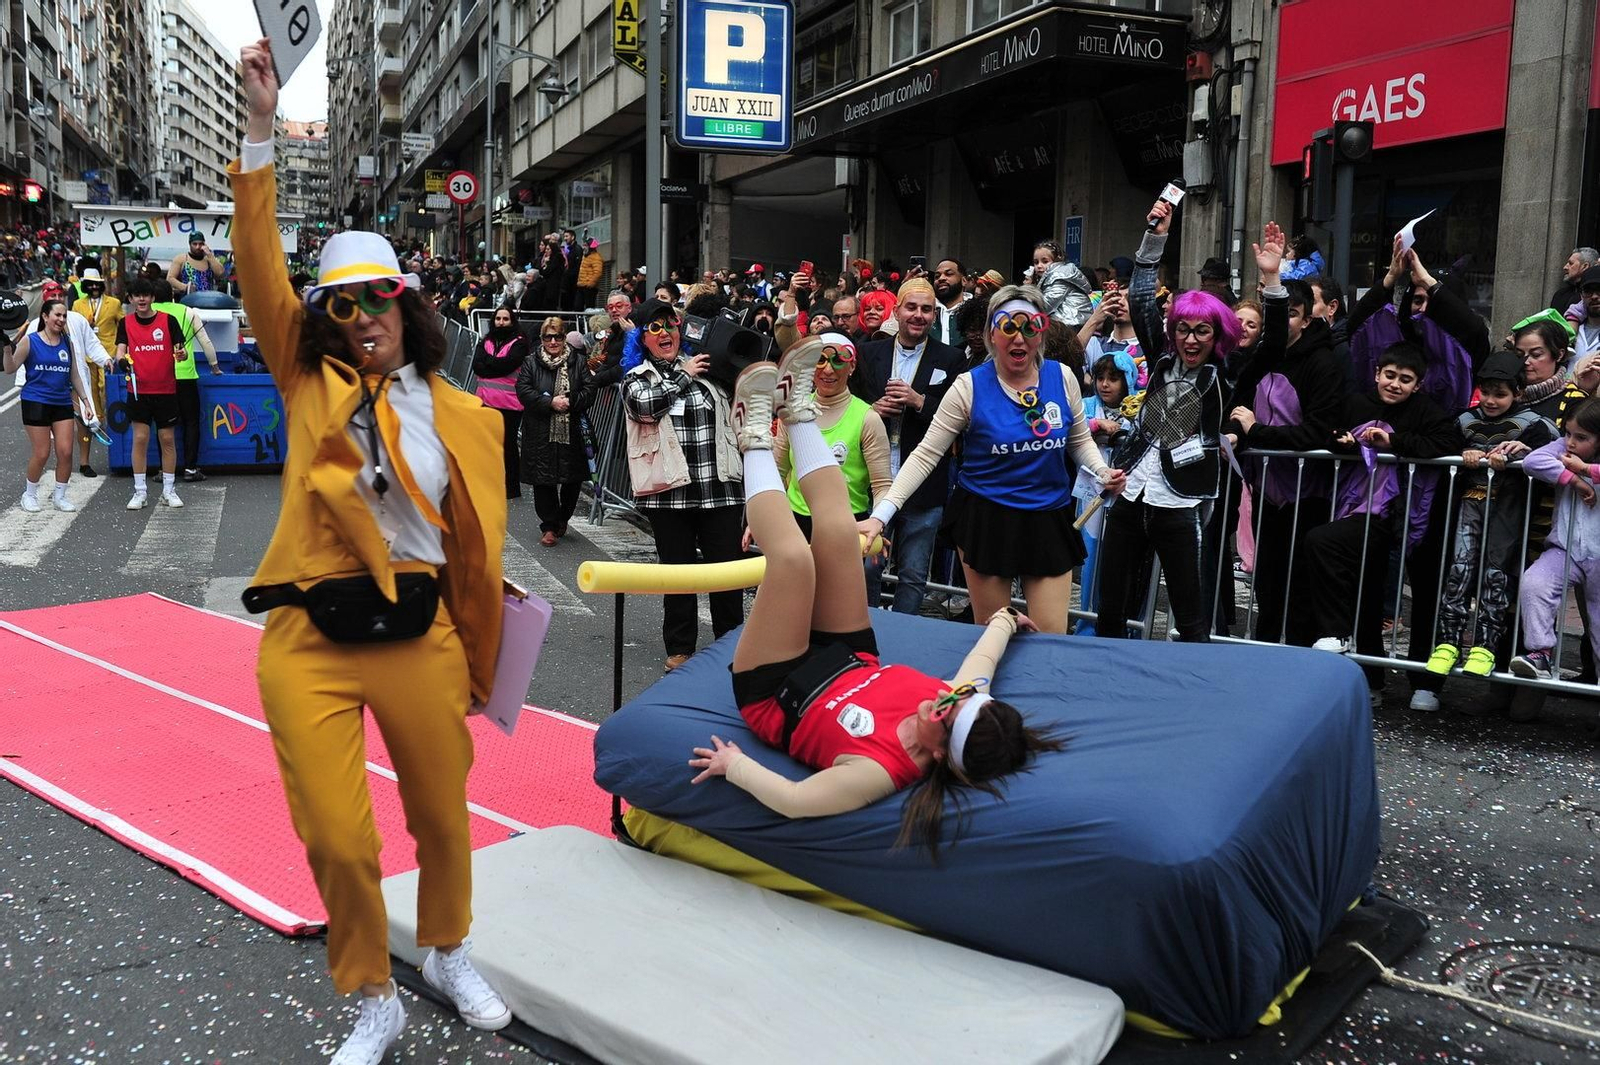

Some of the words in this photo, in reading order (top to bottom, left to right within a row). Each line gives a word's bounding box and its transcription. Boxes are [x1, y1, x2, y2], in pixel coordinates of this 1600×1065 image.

[705, 9, 766, 84] P
[1078, 35, 1110, 55] HOTEL
[980, 50, 1001, 75] HOTEL
[692, 95, 729, 114] JUAN
[736, 98, 774, 117] XXIII
[844, 103, 870, 123] Queres
[870, 91, 896, 113] durmir
[1331, 72, 1427, 125] GAES
[714, 122, 752, 135] LIBRE
[452, 181, 472, 193] 30
[110, 212, 195, 246] Barra
[141, 344, 165, 352] PONTE
[45, 364, 70, 373] LAGOAS
[249, 432, 280, 463] 24
[991, 443, 1009, 455] AS
[1012, 436, 1067, 454] LAGOAS
